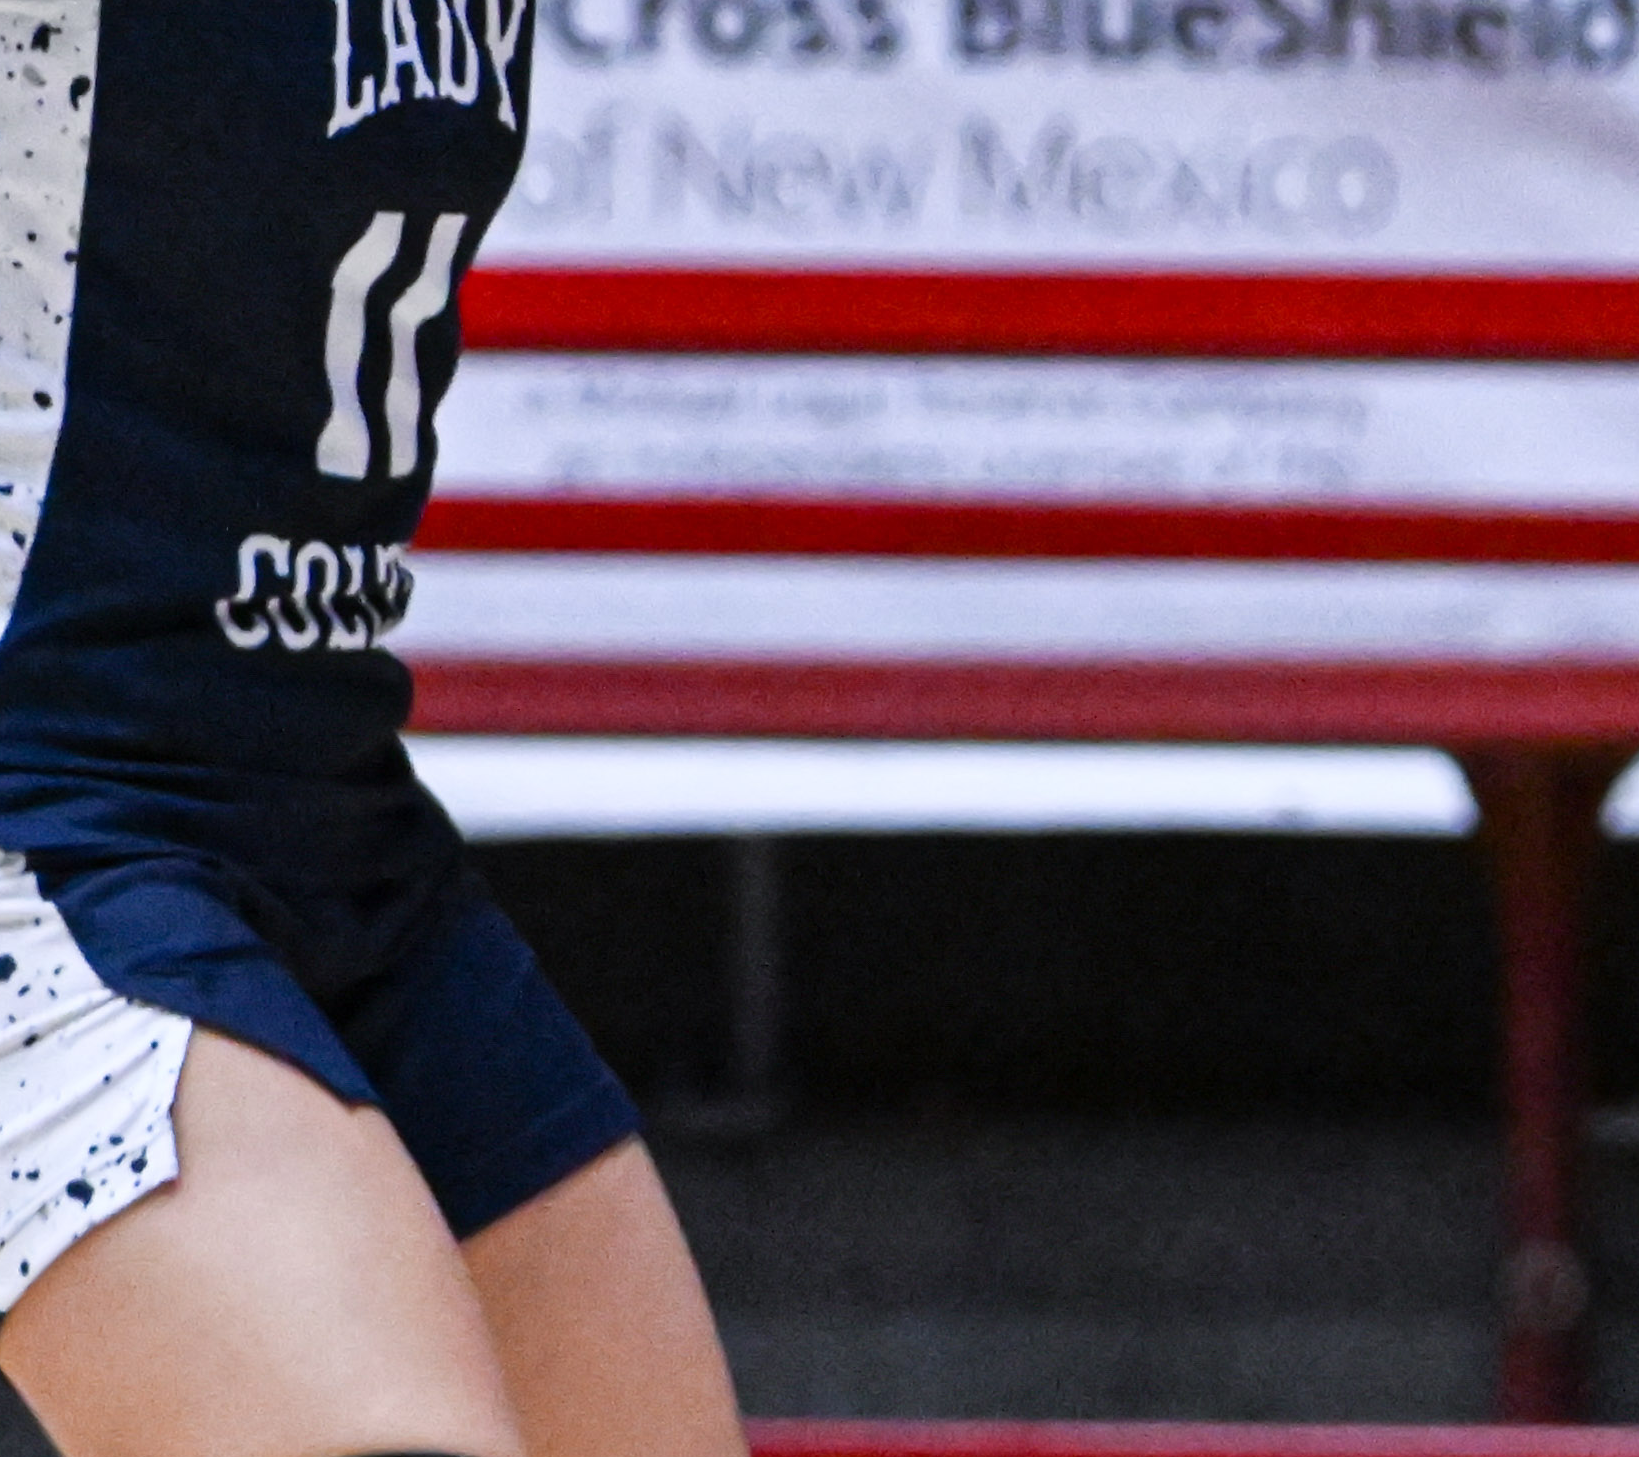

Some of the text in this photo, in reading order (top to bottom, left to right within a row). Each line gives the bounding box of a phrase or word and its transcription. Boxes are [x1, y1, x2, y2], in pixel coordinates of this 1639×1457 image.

[651, 118, 929, 225] New
[964, 115, 1398, 238] Mexico
[316, 211, 468, 479] 11
